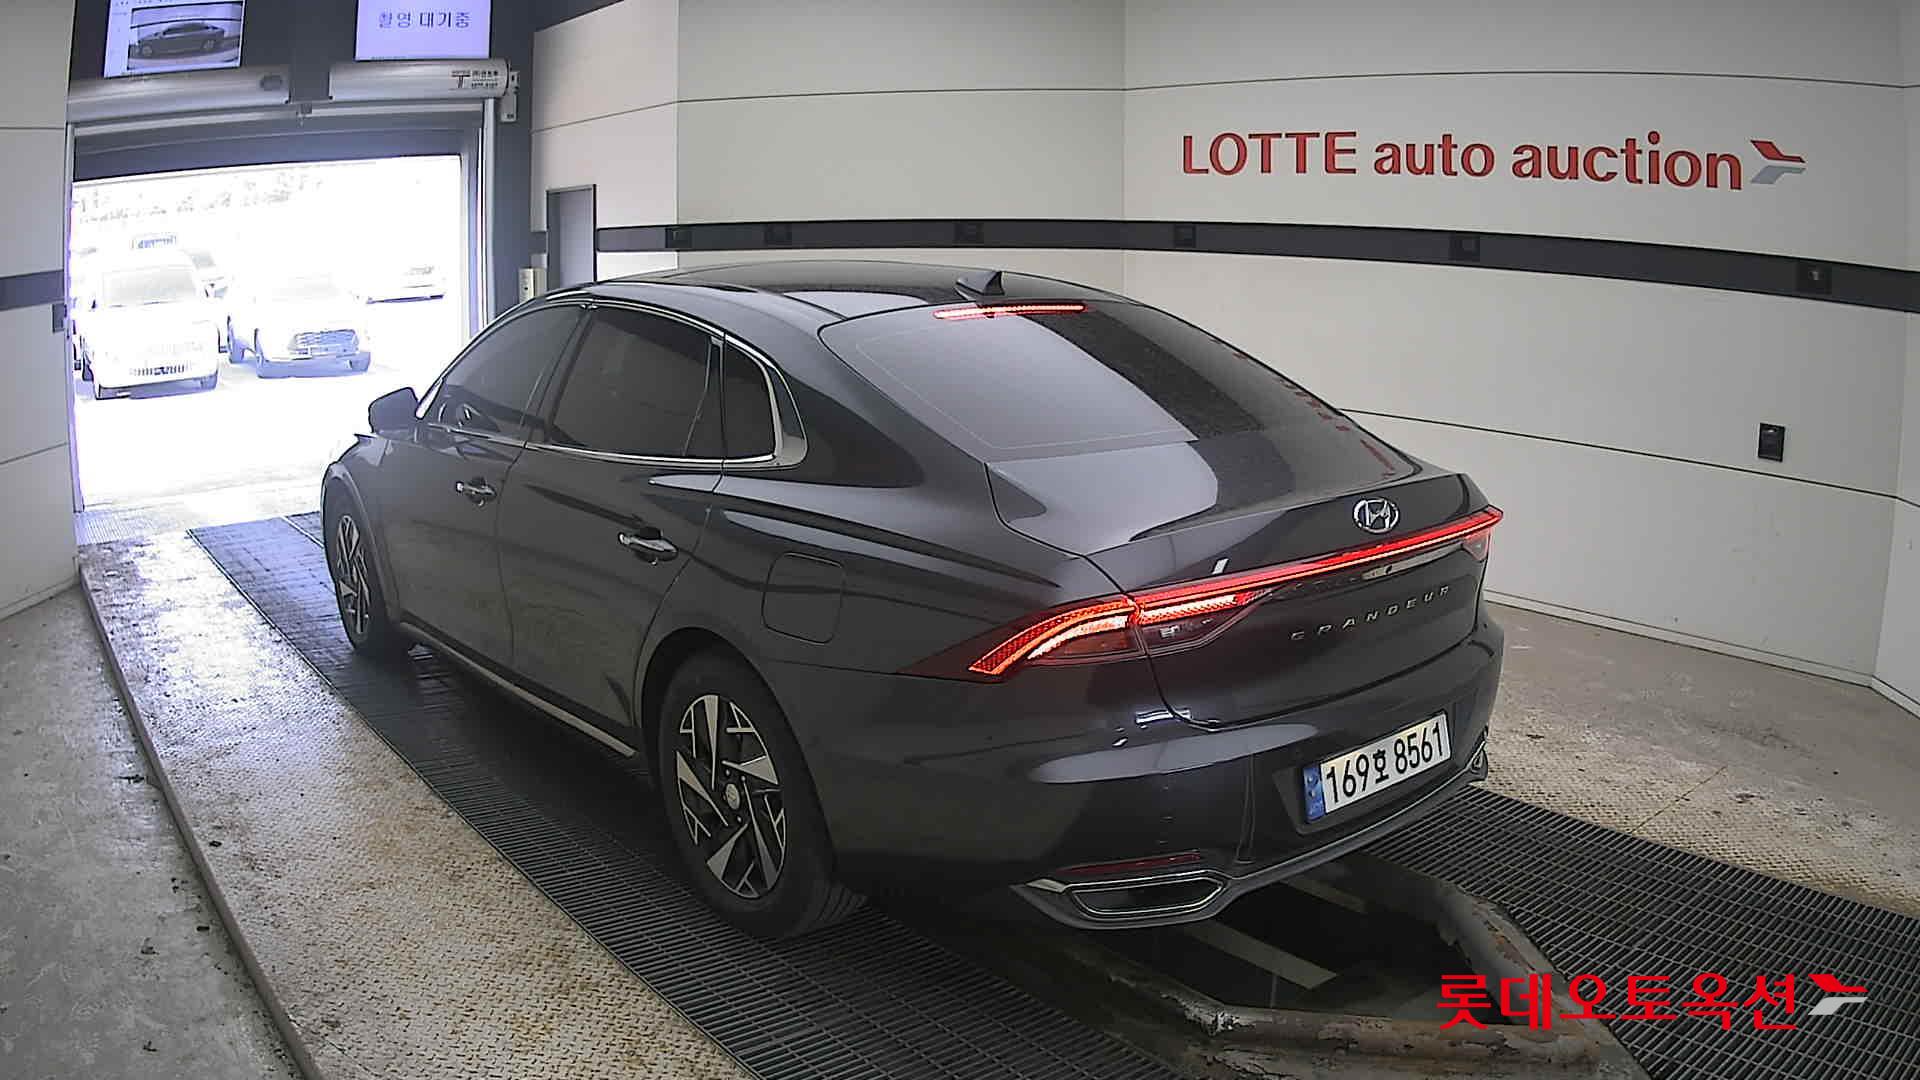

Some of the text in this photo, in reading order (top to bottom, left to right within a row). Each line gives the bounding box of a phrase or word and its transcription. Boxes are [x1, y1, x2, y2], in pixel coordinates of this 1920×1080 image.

[419, 11, 470, 29] 대기중
[1182, 130, 1743, 190] LOTTE auto auction
[1289, 585, 1450, 641] GRANDEUR
[1393, 721, 1444, 775] 8561
